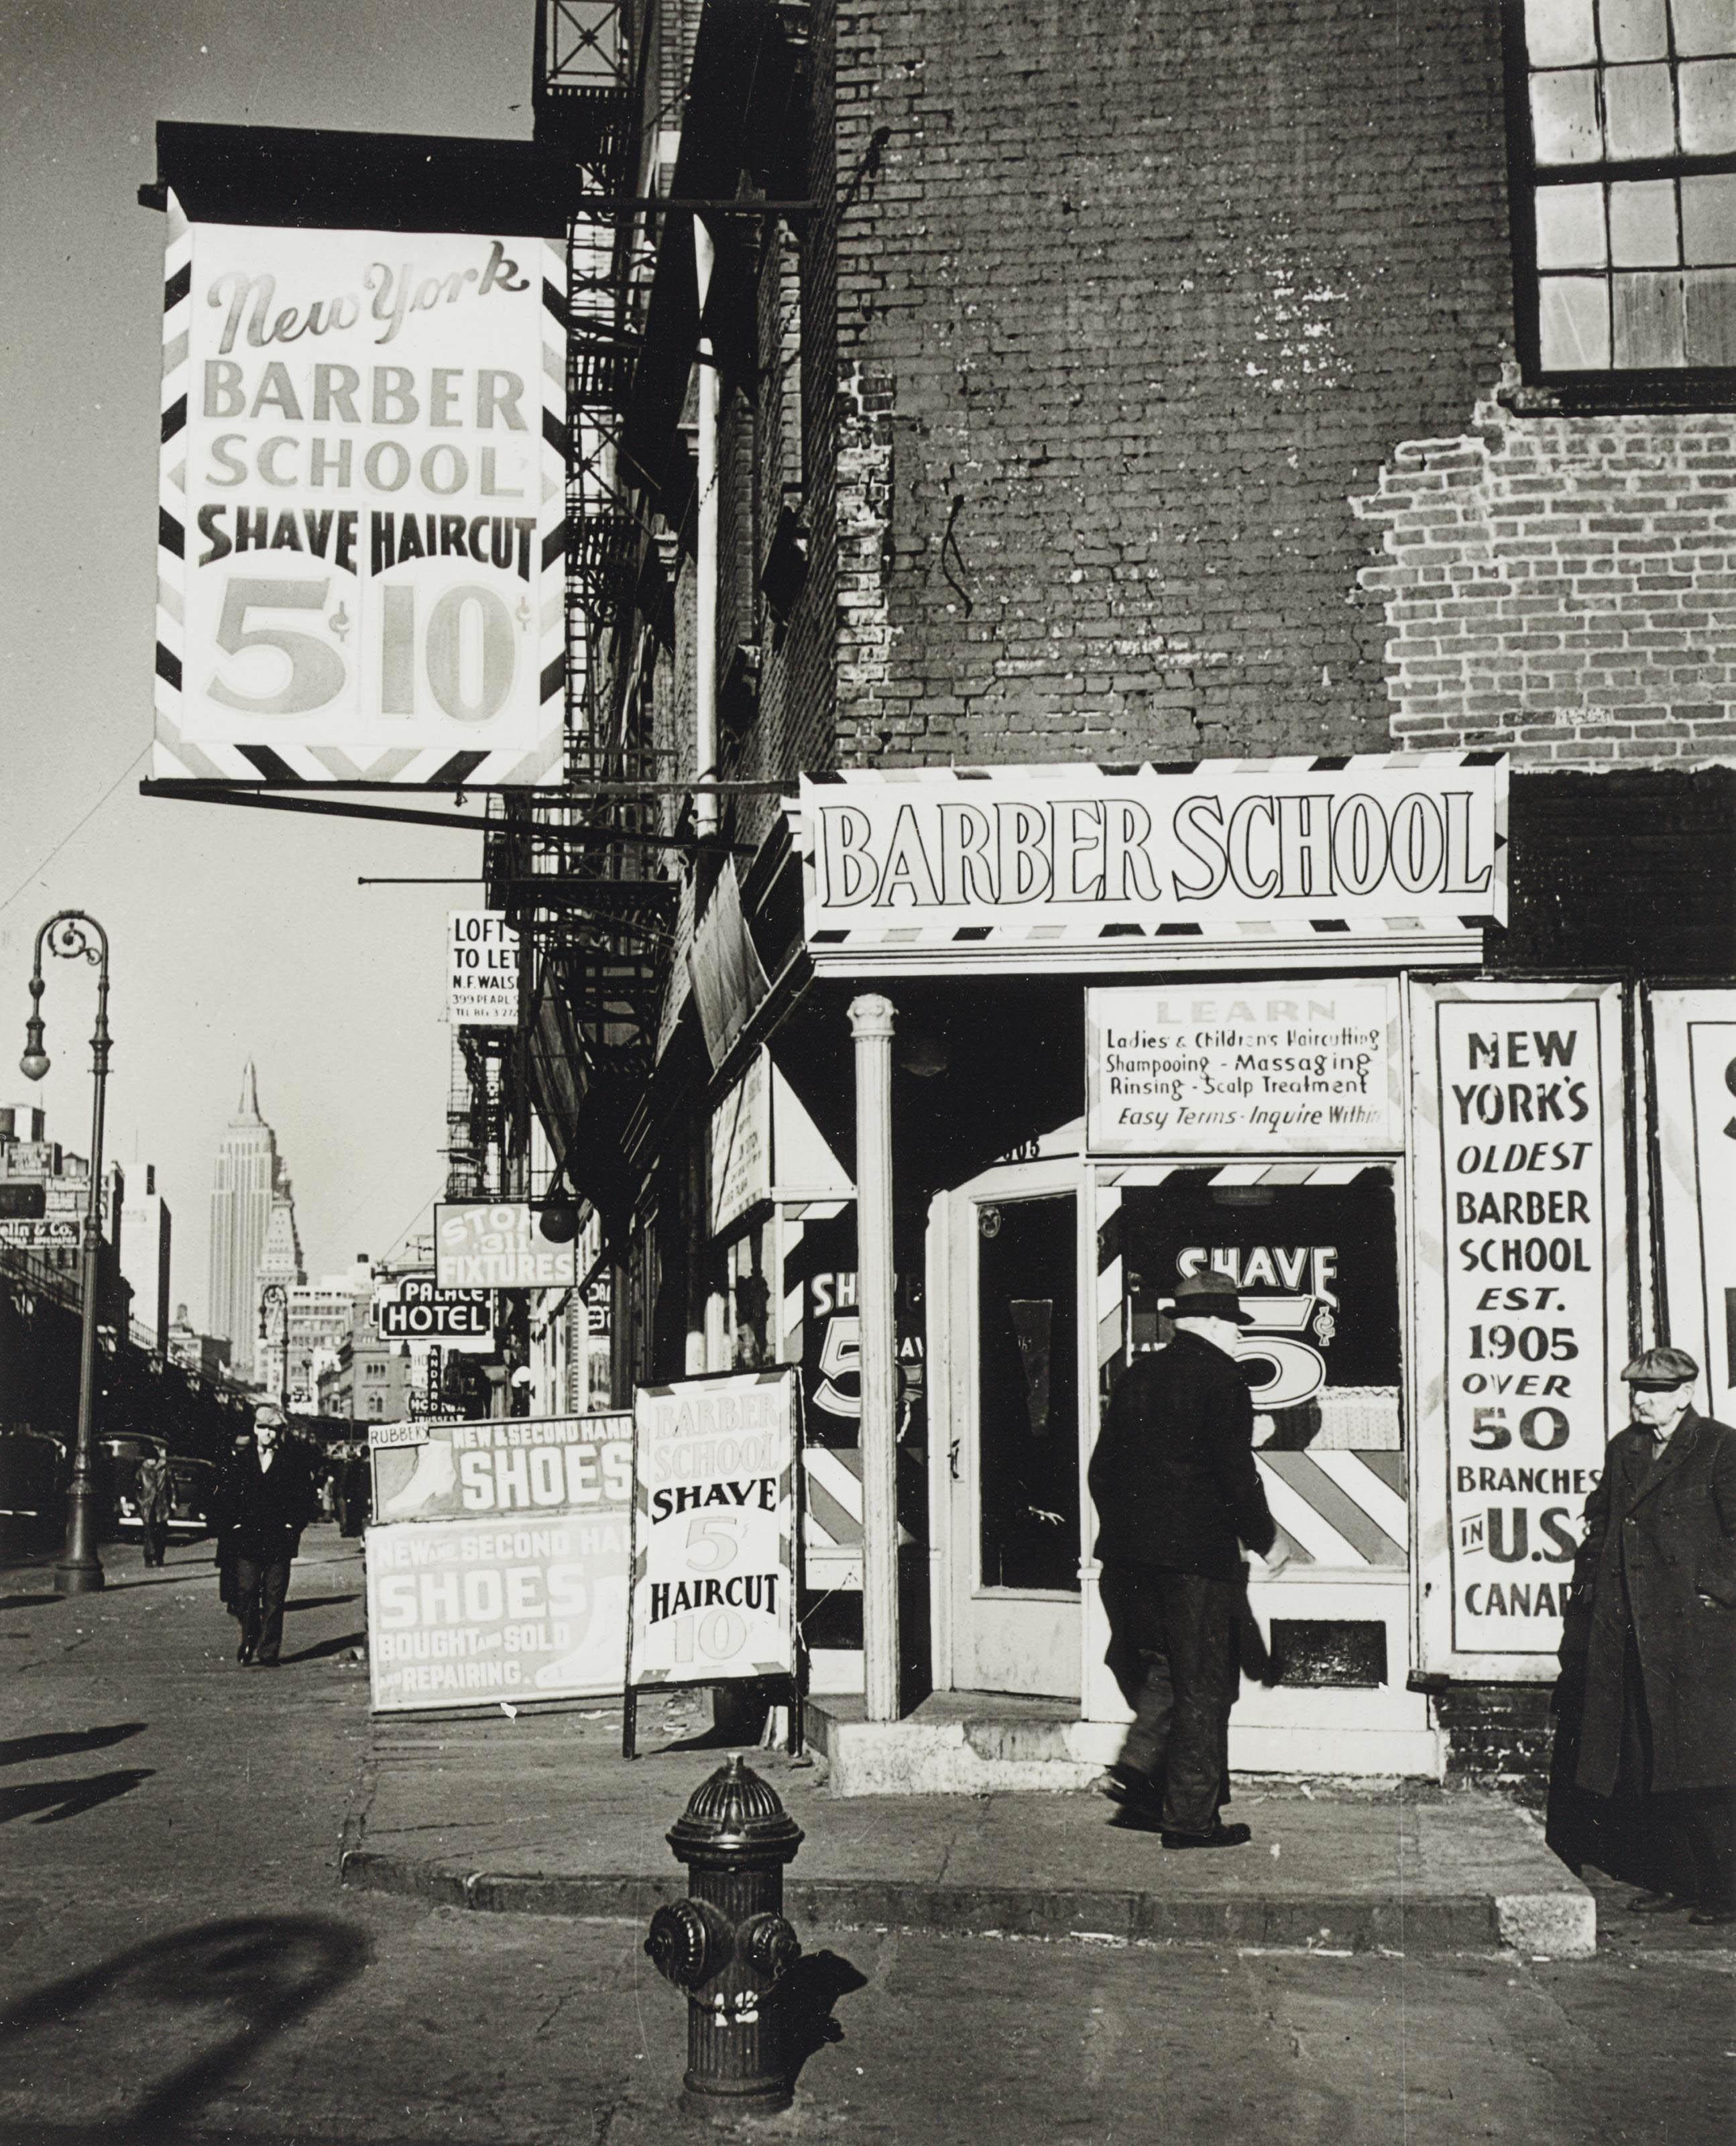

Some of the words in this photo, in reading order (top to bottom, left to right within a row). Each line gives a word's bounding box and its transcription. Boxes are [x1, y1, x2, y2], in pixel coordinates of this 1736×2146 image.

[207, 271, 359, 355] New
[364, 240, 530, 345] York
[202, 359, 529, 432] BARBER
[205, 433, 524, 498] SCHOOL
[197, 504, 359, 577] SHAVE
[371, 510, 537, 583] HAIRCUT
[819, 799, 1162, 908] BARBER
[1172, 792, 1493, 902] SCHOOL
[455, 918, 520, 942] LOFT
[454, 948, 479, 968] TO
[488, 949, 520, 969] LET
[478, 976, 519, 990] WALS
[1157, 1000, 1336, 1025] LEARN
[1196, 1029, 1278, 1049] Children's
[1287, 1027, 1380, 1052] Haircutting
[1468, 1030, 1578, 1070] NEW
[1106, 1054, 1210, 1080] Shampooing
[1235, 1053, 1373, 1076] Massaging
[1111, 1076, 1185, 1102] Rinsing
[1203, 1076, 1253, 1098] Scalp
[1262, 1074, 1367, 1094] Treatment
[1452, 1075, 1589, 1125] YORK'S
[1118, 1107, 1169, 1131] Easy
[1249, 1103, 1323, 1134] Inquire
[1456, 1142, 1593, 1175] OLDEST
[1456, 1190, 1590, 1225] BARBER
[439, 1253, 571, 1284] FIXTURES
[1460, 1237, 1591, 1272] SCHOOL
[406, 1283, 484, 1302] PALACE
[1476, 1287, 1566, 1311] EST.
[390, 1306, 486, 1331] HOTEL
[1469, 1324, 1579, 1362] 1905
[1462, 1373, 1572, 1398] OVER
[452, 1426, 491, 1449] NEW
[509, 1420, 579, 1446] SECOND
[581, 1417, 632, 1441] HAND
[655, 1392, 778, 1441] BARBER
[1469, 1406, 1570, 1452] 50
[654, 1432, 779, 1482] SCHOOL
[461, 1441, 632, 1510] SHOES
[1457, 1467, 1603, 1495] BRANCHES
[652, 1477, 776, 1525] SHAVE
[462, 1530, 571, 1561] SECOND
[580, 1526, 630, 1555] HA
[1462, 1520, 1484, 1547] IN
[378, 1563, 587, 1629] SHOES
[650, 1574, 779, 1624] HAIRCUT
[378, 1628, 480, 1662] BOUGHT
[504, 1622, 570, 1652] SOLD
